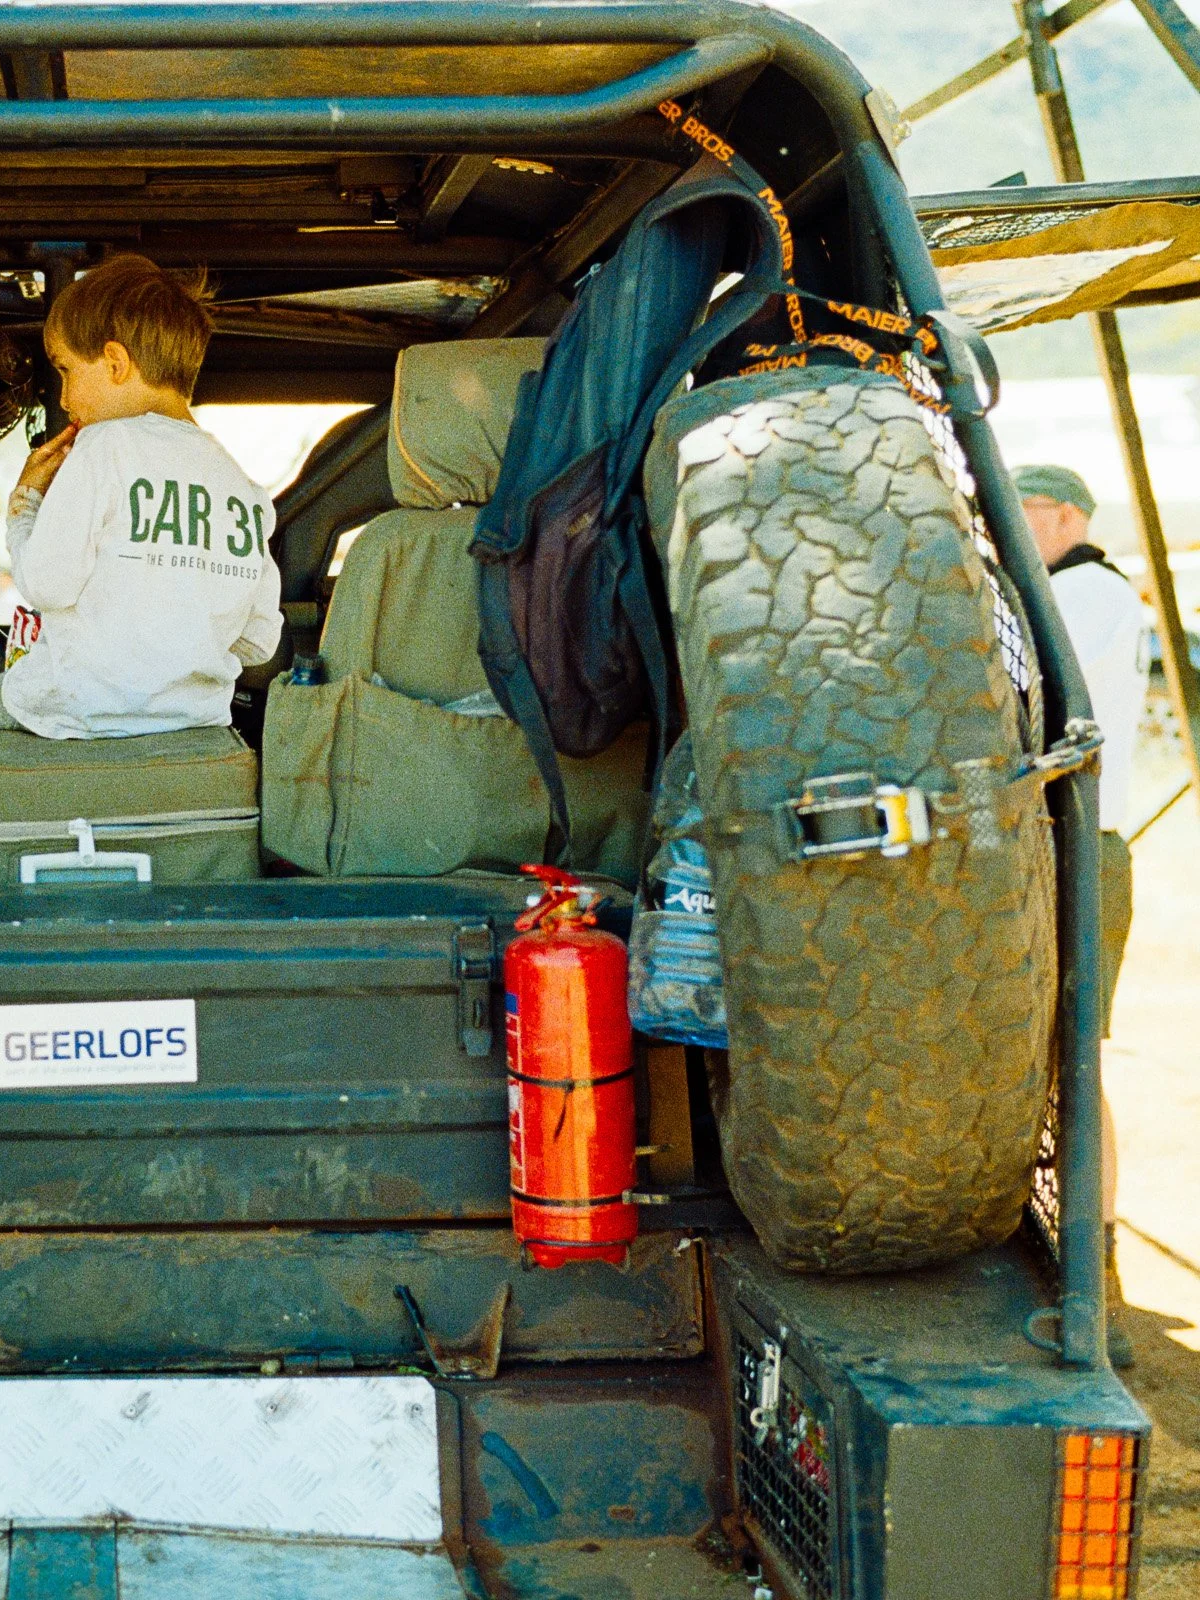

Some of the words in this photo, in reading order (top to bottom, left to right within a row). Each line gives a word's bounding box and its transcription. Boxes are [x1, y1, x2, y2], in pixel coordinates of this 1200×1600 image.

[682, 117, 735, 167] BROS.
[758, 187, 794, 271] MAIER
[827, 300, 912, 335] MAIER
[129, 478, 211, 551] CAR
[147, 554, 164, 567] THE
[171, 555, 206, 571] GREEN
[210, 561, 258, 580] GODDESS
[4, 1027, 188, 1062] GEERLOFS
